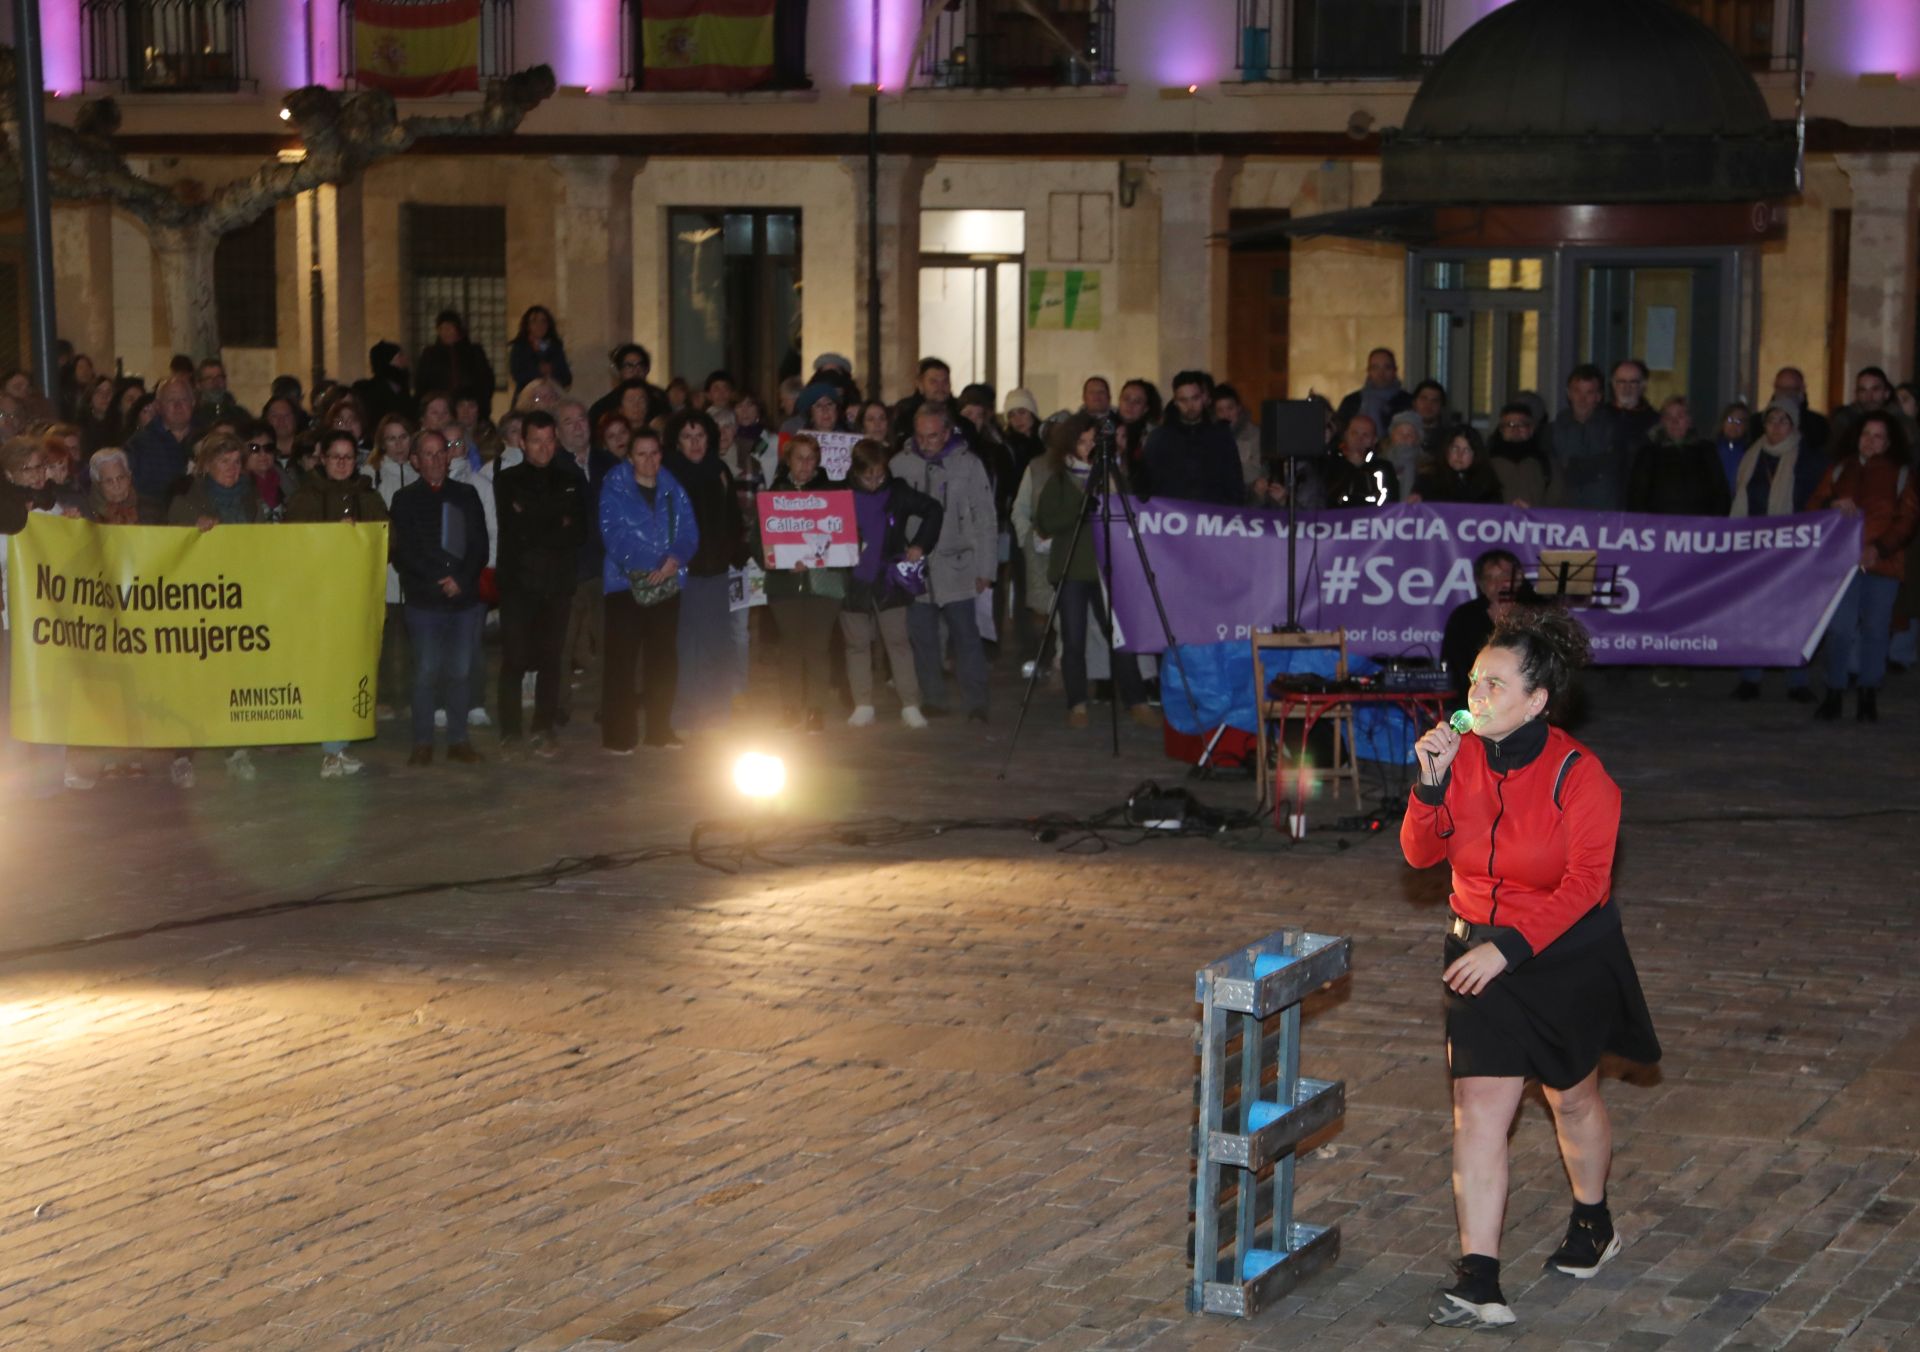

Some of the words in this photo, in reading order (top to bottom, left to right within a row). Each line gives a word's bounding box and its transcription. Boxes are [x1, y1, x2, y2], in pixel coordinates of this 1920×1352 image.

[767, 517, 813, 531] Cállate
[827, 518, 842, 531] tú
[1196, 514, 1264, 538] MÁS
[1273, 518, 1449, 541] VIOLENCIA
[1457, 518, 1589, 549] CONTRA
[1597, 527, 1655, 552] LAS
[1664, 525, 1822, 553] MUJERES!
[37, 564, 66, 602] No
[72, 571, 114, 608] más
[117, 575, 243, 611] violencia
[32, 616, 107, 652] contra
[112, 618, 147, 654] las
[155, 618, 271, 661] mujeres
[1372, 627, 1397, 641] los
[1614, 635, 1636, 649] de
[1642, 635, 1718, 650] Palencia
[229, 683, 302, 708] AMNISTÍA
[230, 709, 304, 723] INTERNACIONAL
